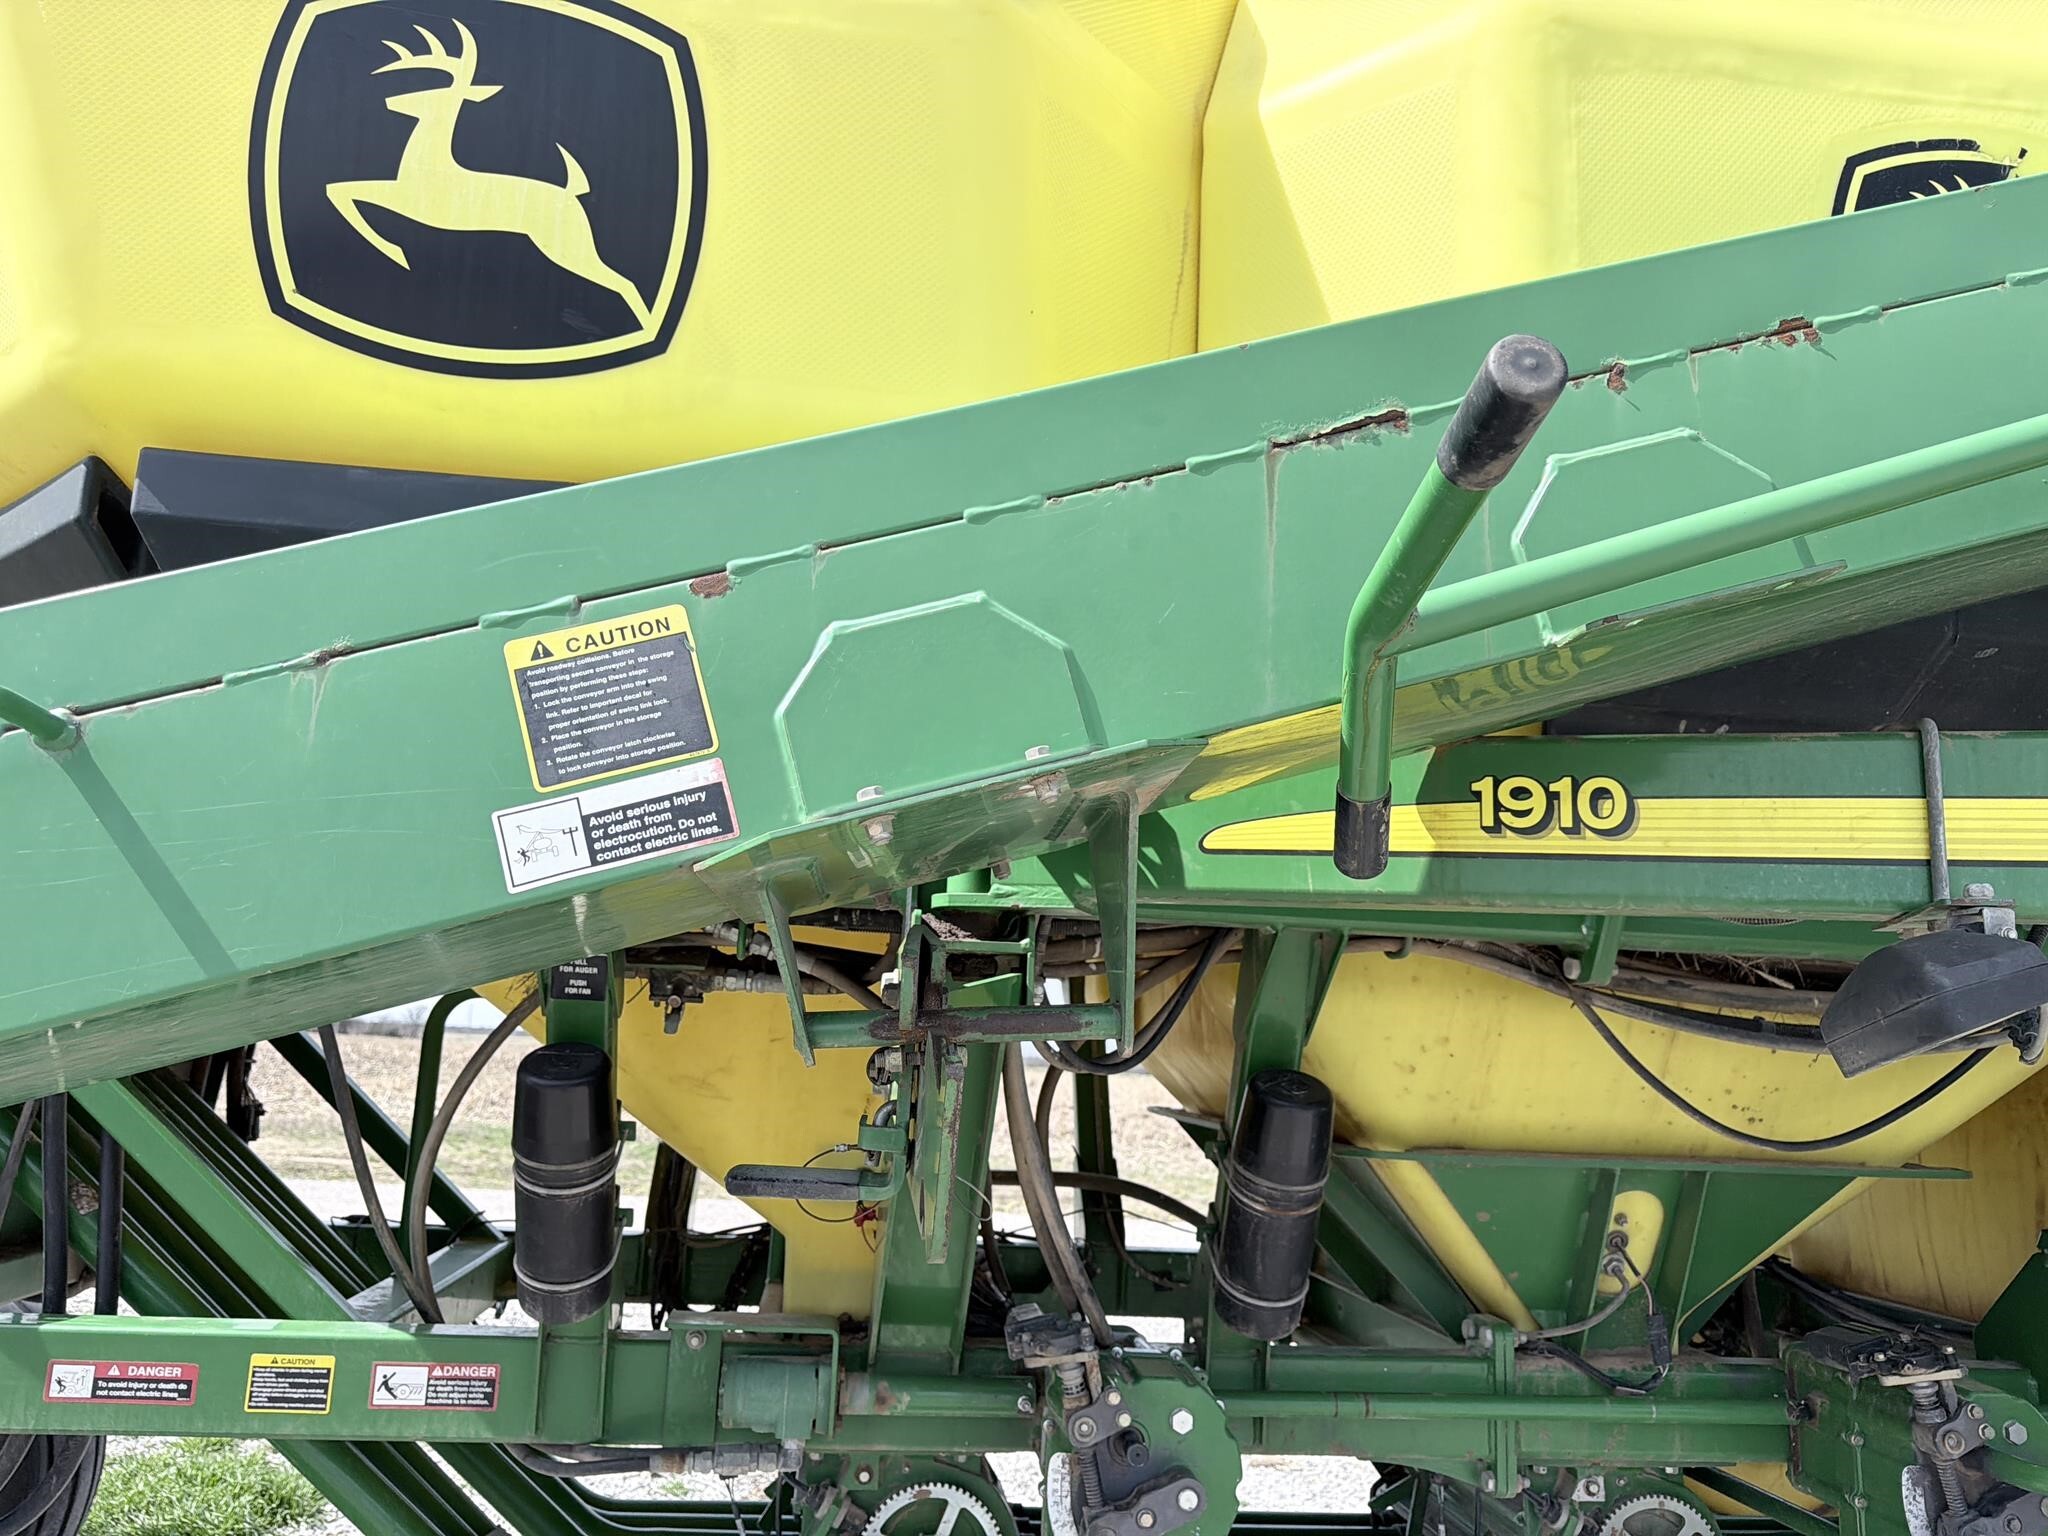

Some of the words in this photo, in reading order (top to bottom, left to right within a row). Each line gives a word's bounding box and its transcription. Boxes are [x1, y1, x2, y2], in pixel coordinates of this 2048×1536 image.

[566, 617, 671, 653] CAUTION
[526, 667, 545, 676] Avoid
[546, 661, 575, 671] roadway
[576, 653, 611, 665] collisions.
[612, 648, 635, 657] Before
[528, 674, 570, 687] transporting
[571, 668, 594, 678] secure
[595, 661, 626, 672] conveyor
[649, 650, 674, 660] storage
[531, 688, 558, 699] position
[569, 677, 607, 691] performing
[607, 672, 627, 680] these
[628, 668, 648, 676] steps:
[542, 699, 560, 707] Lock
[573, 689, 604, 700] conveyor
[620, 682, 634, 690] into
[647, 675, 667, 683] swing
[548, 720, 570, 731] proper
[572, 712, 608, 724] orientation
[609, 708, 617, 716] of
[618, 705, 639, 714] swing
[639, 701, 652, 709] link
[653, 697, 669, 705] lock.
[561, 706, 579, 715] Refer
[589, 696, 622, 708] important
[623, 691, 642, 701] decal
[550, 732, 569, 741] Place
[582, 722, 614, 733] conveyor
[636, 711, 661, 721] storage
[553, 742, 582, 753] position.
[555, 754, 578, 763] Rotate
[591, 743, 623, 755] conveyor
[624, 739, 641, 747] latch
[642, 731, 675, 743] clockwise
[566, 764, 581, 772] lock
[582, 757, 614, 768] conveyor
[630, 747, 656, 757] storage
[657, 741, 685, 752] position.
[589, 809, 623, 827] Avoid
[626, 800, 670, 817] serious
[672, 791, 706, 806] injury
[1470, 775, 1635, 836] 1910
[591, 828, 604, 838] or
[607, 818, 641, 834] death
[643, 812, 672, 825] from
[593, 824, 675, 849] electrocution.
[677, 818, 695, 829] Do
[697, 811, 717, 824] not
[596, 842, 642, 861] contact
[644, 832, 688, 849] electric
[690, 825, 722, 838] lines.
[574, 966, 598, 974] AUGER
[578, 987, 591, 995] FAN
[127, 1366, 182, 1377] DANGER
[128, 1381, 148, 1389] injury
[443, 1366, 496, 1377] DANGER
